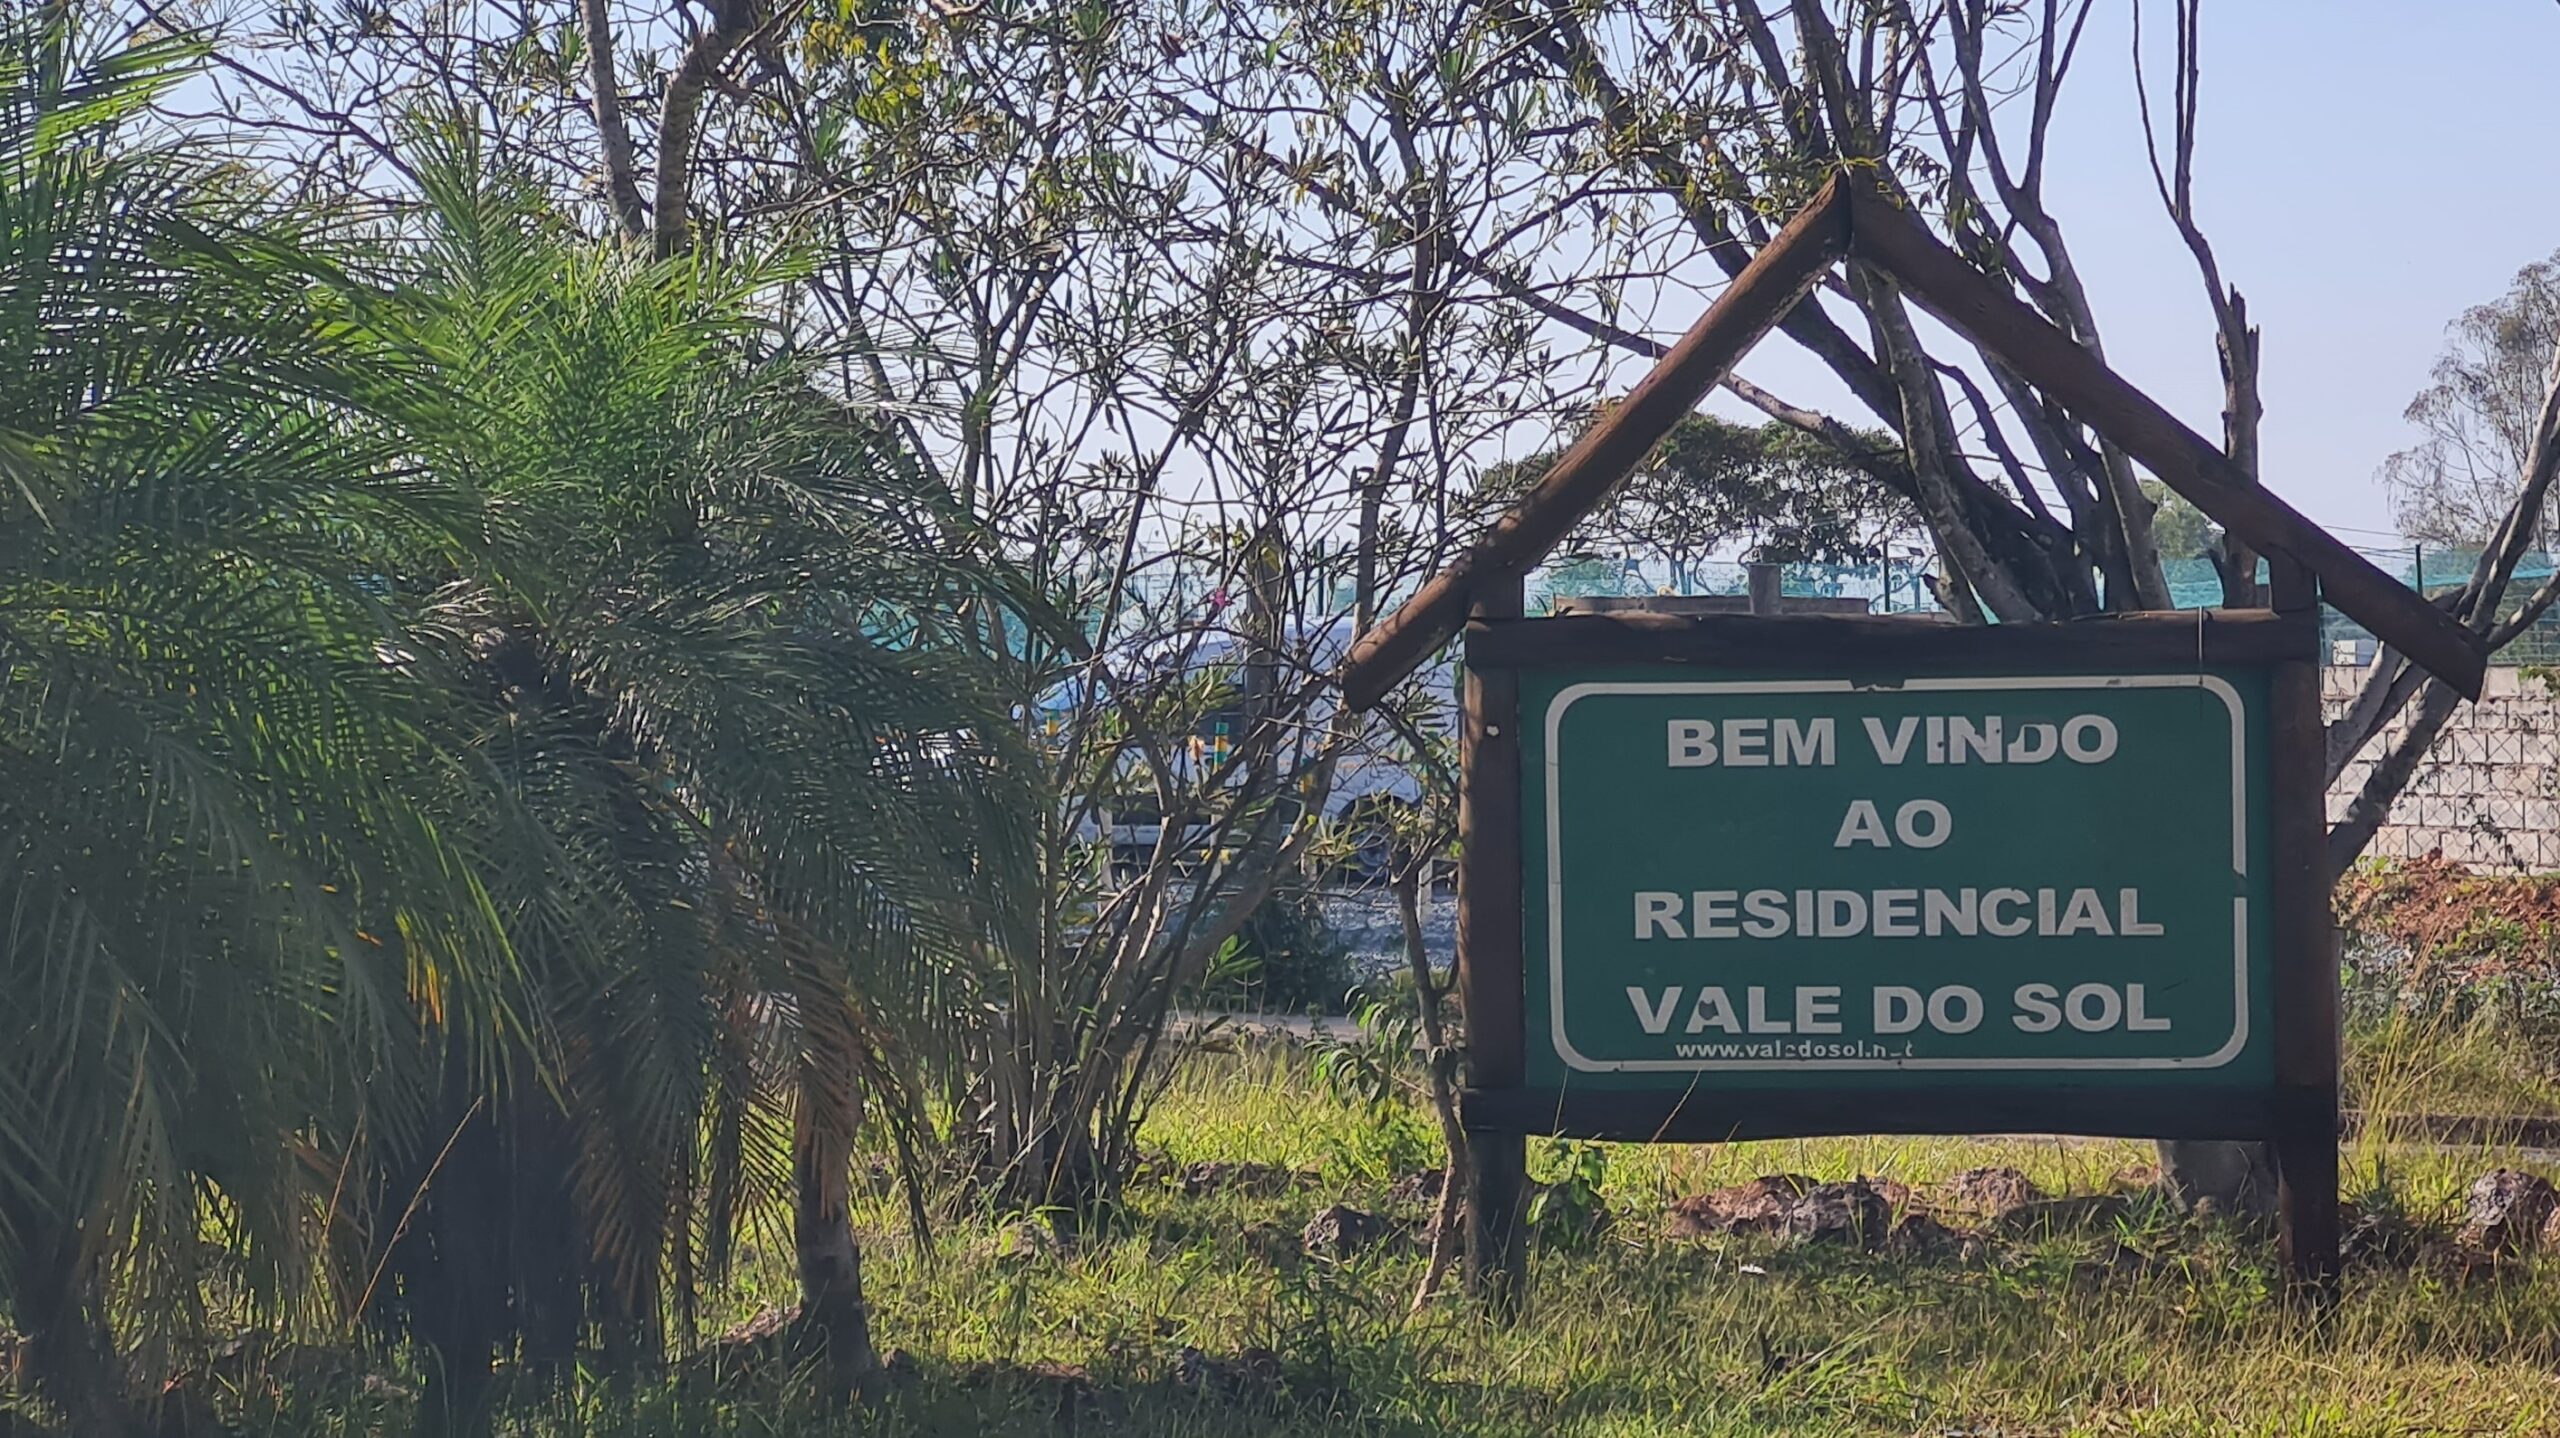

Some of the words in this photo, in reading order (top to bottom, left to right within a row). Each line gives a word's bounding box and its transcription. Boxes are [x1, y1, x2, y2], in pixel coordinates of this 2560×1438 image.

[1667, 718, 1835, 767] BEM
[1861, 714, 2118, 765] VINDO
[1834, 799, 1952, 848] AO
[1634, 887, 2164, 940] RESIDENCIAL
[1626, 986, 1842, 1034] VALE
[1873, 985, 1984, 1034] DO
[2012, 983, 2171, 1032] SOL
[1675, 1040, 1913, 1058] www.valedosol.nt
